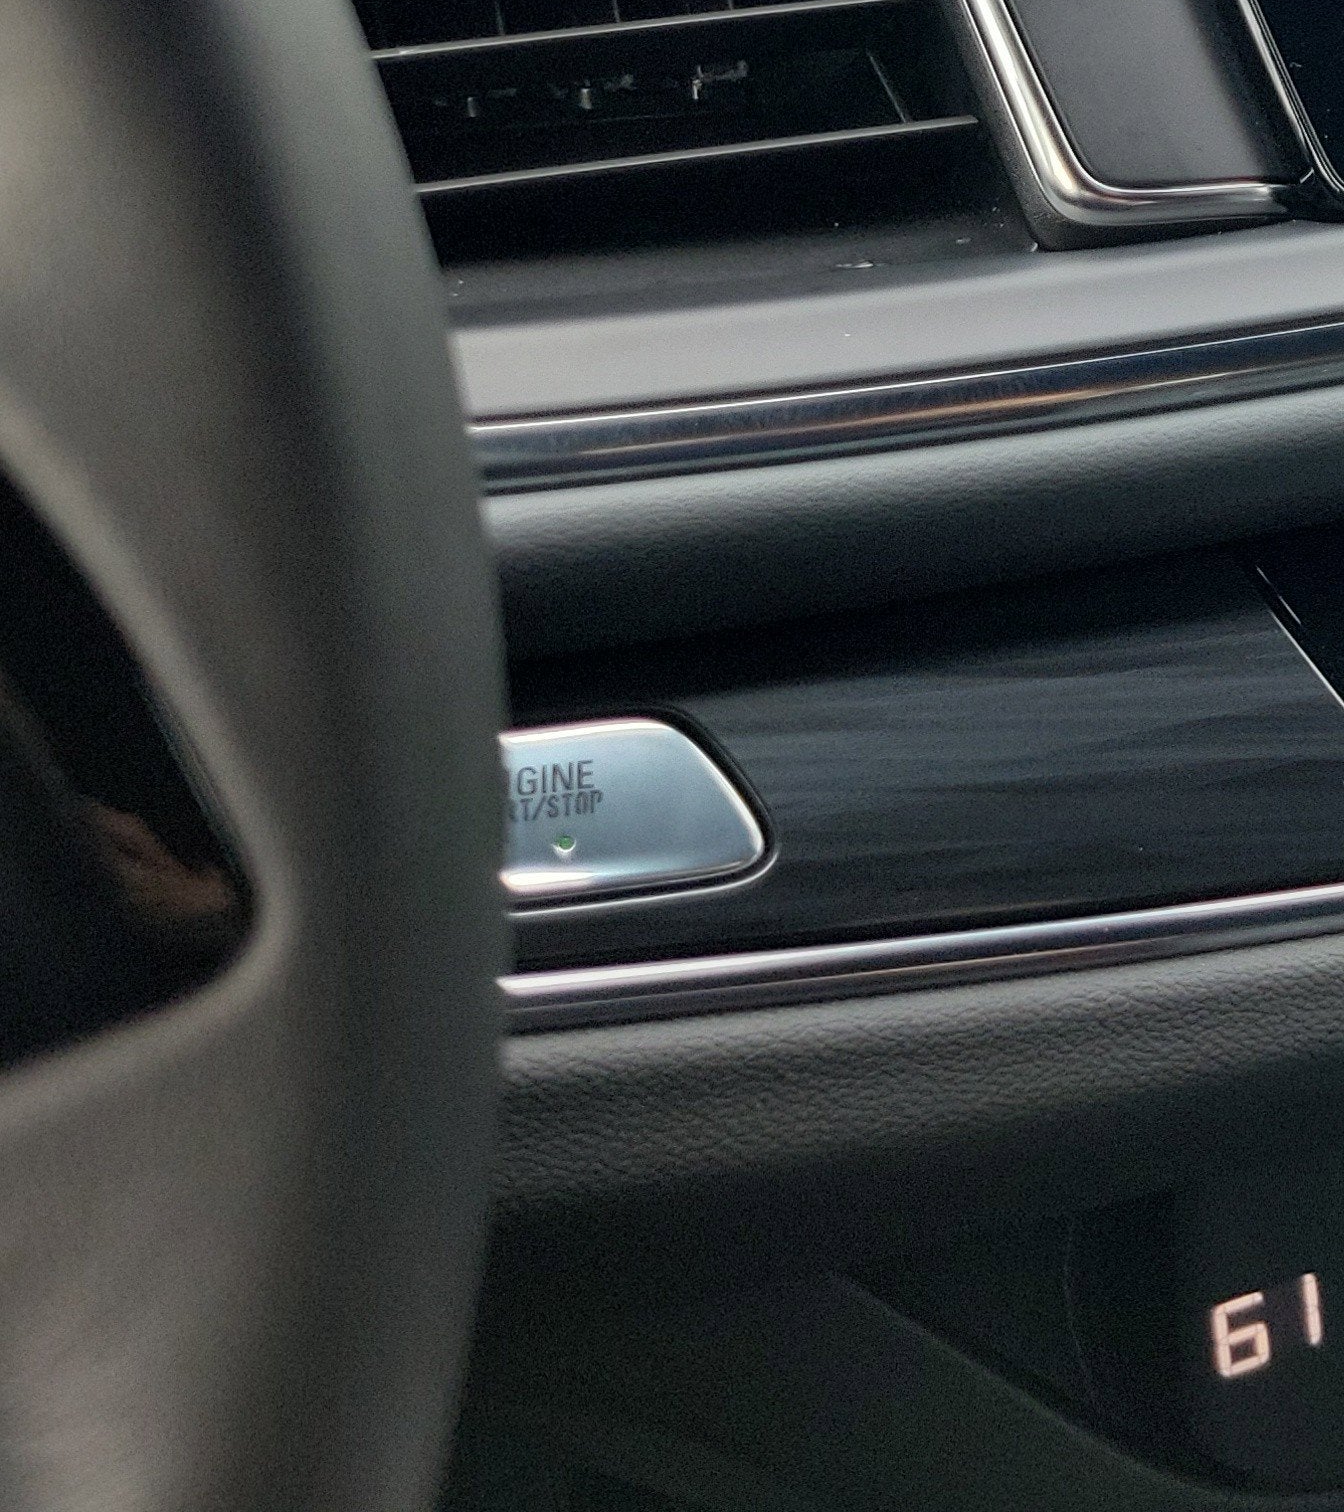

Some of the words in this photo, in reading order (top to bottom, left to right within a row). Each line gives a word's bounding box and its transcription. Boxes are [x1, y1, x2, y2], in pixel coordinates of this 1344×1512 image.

[516, 758, 595, 796] GINE
[511, 788, 604, 822] T/STOP
[1211, 1272, 1323, 1378] 61
